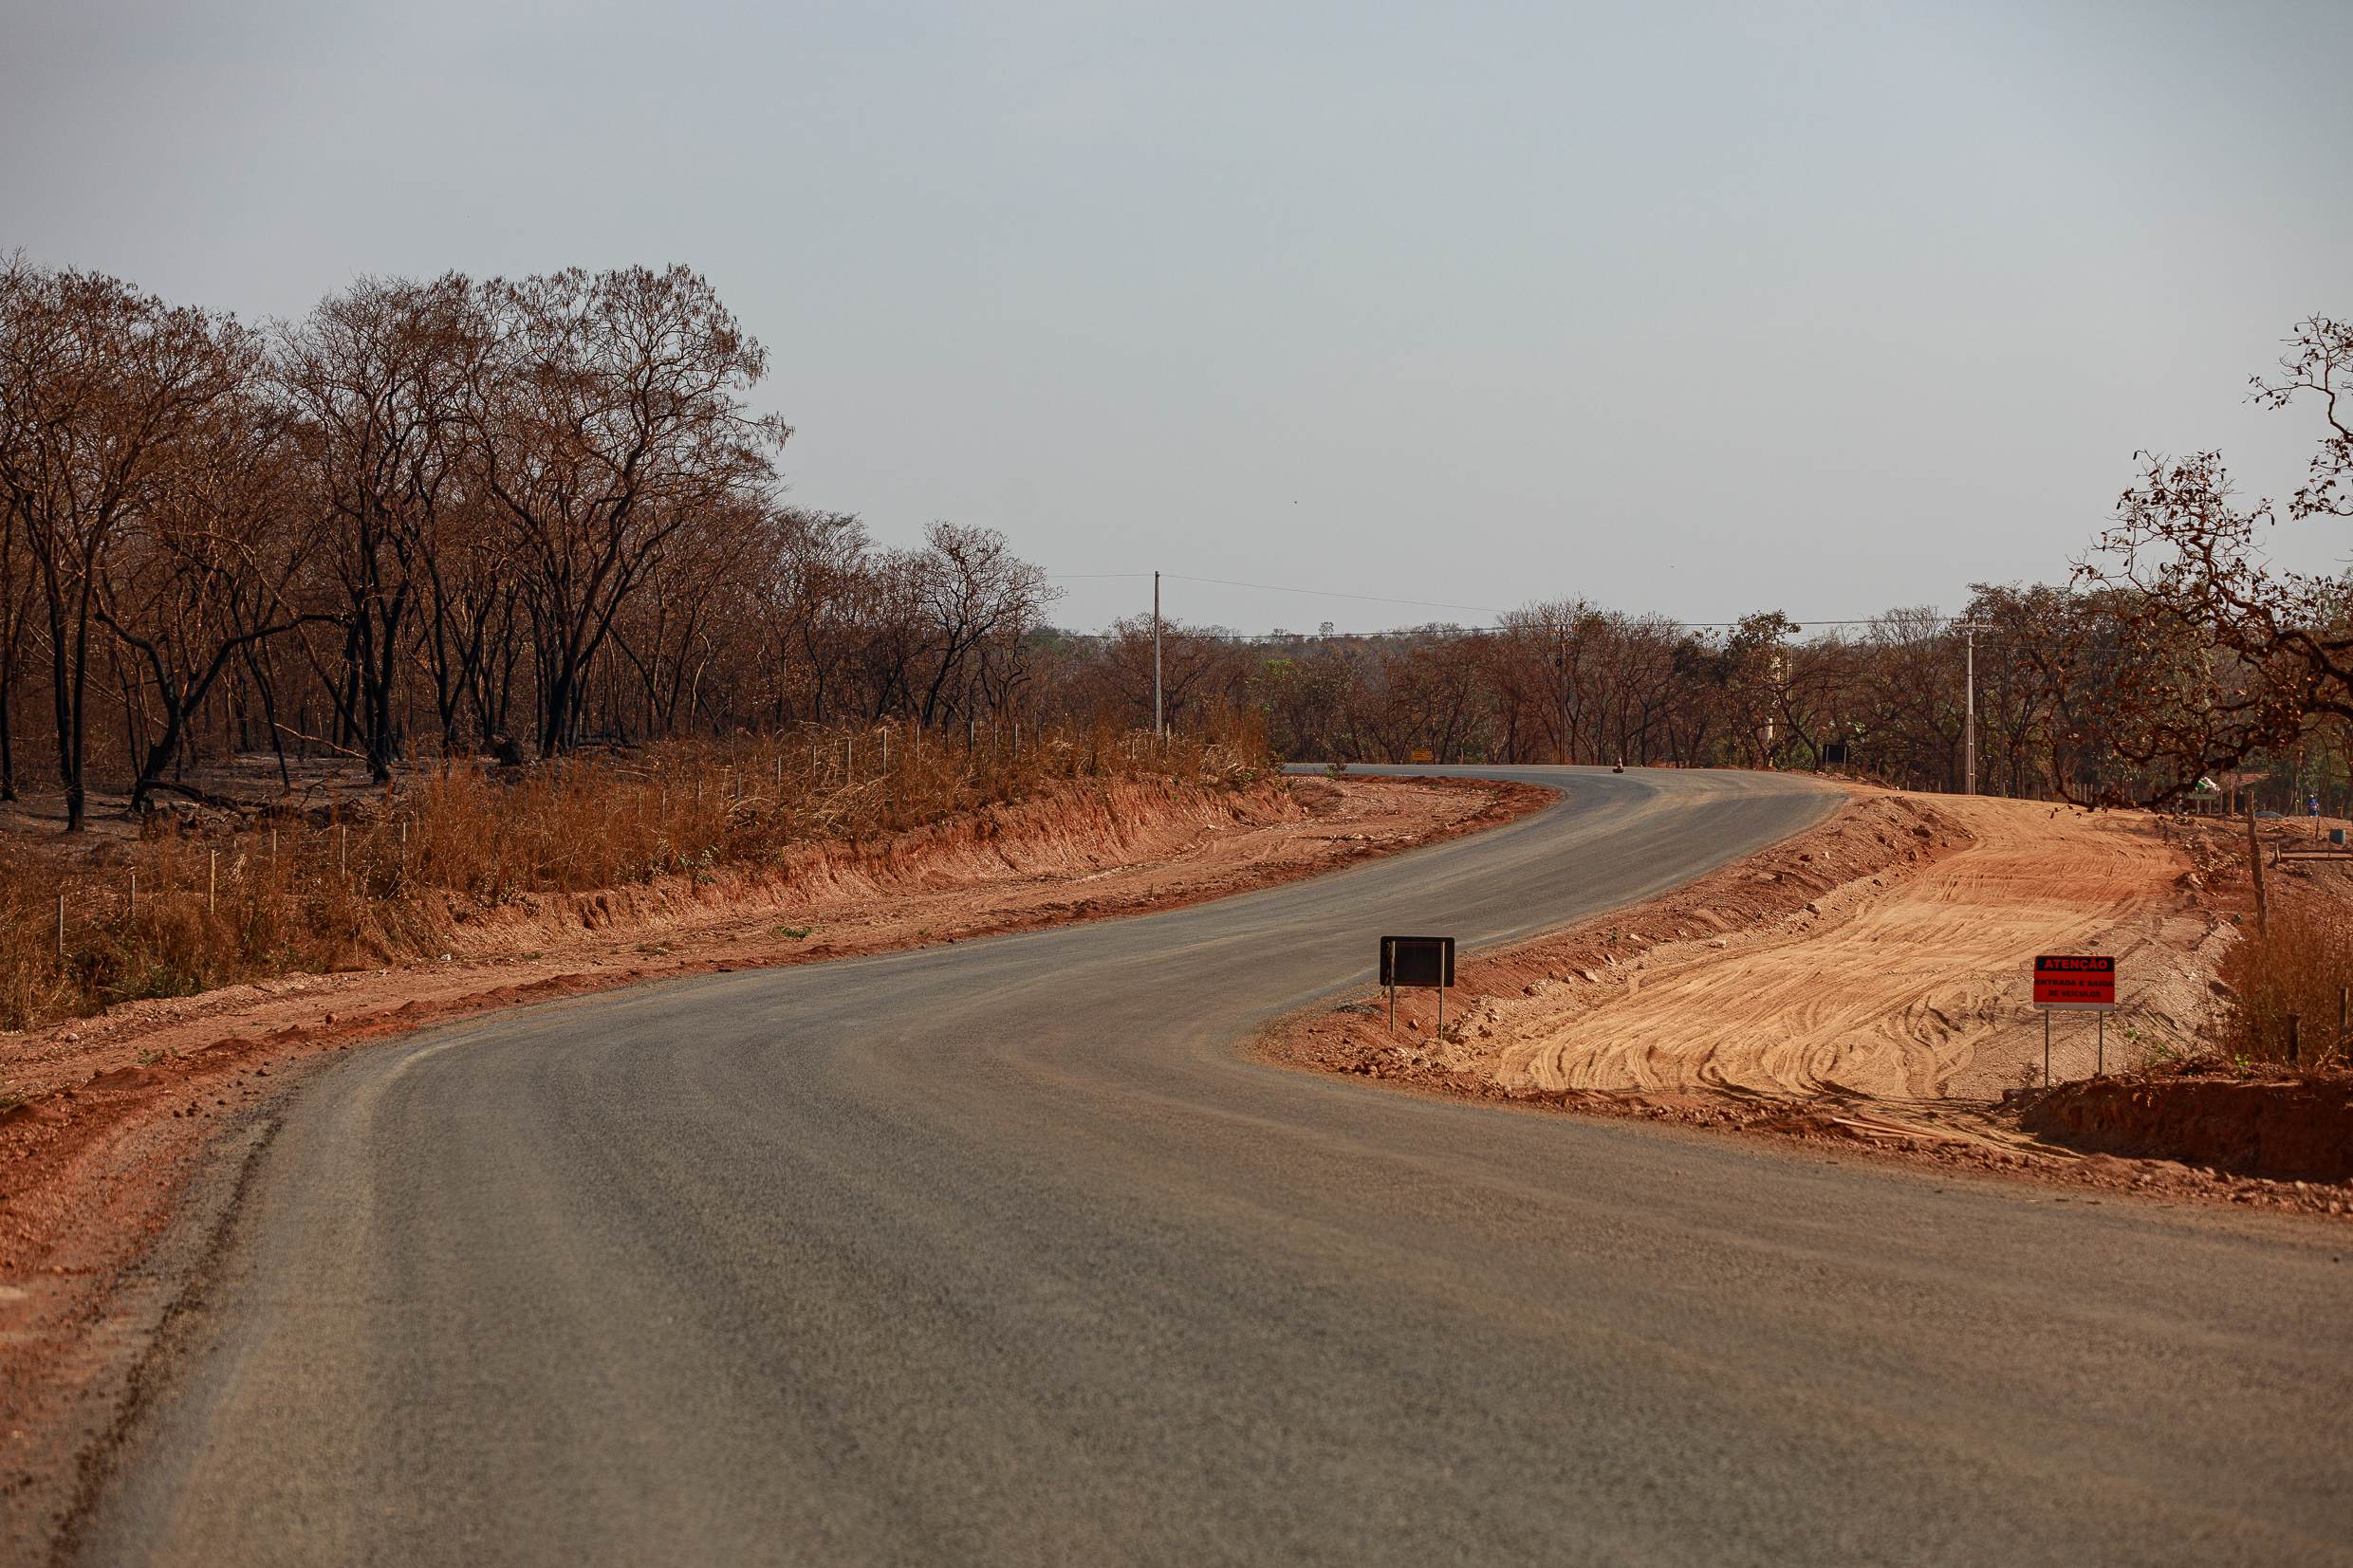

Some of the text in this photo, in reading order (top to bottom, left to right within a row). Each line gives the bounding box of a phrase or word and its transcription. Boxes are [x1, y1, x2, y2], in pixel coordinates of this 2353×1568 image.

[2044, 958, 2108, 971] ATENÇÃO
[2087, 979, 2114, 987] SAÍDA
[2061, 989, 2101, 998] VEÍCULOS
